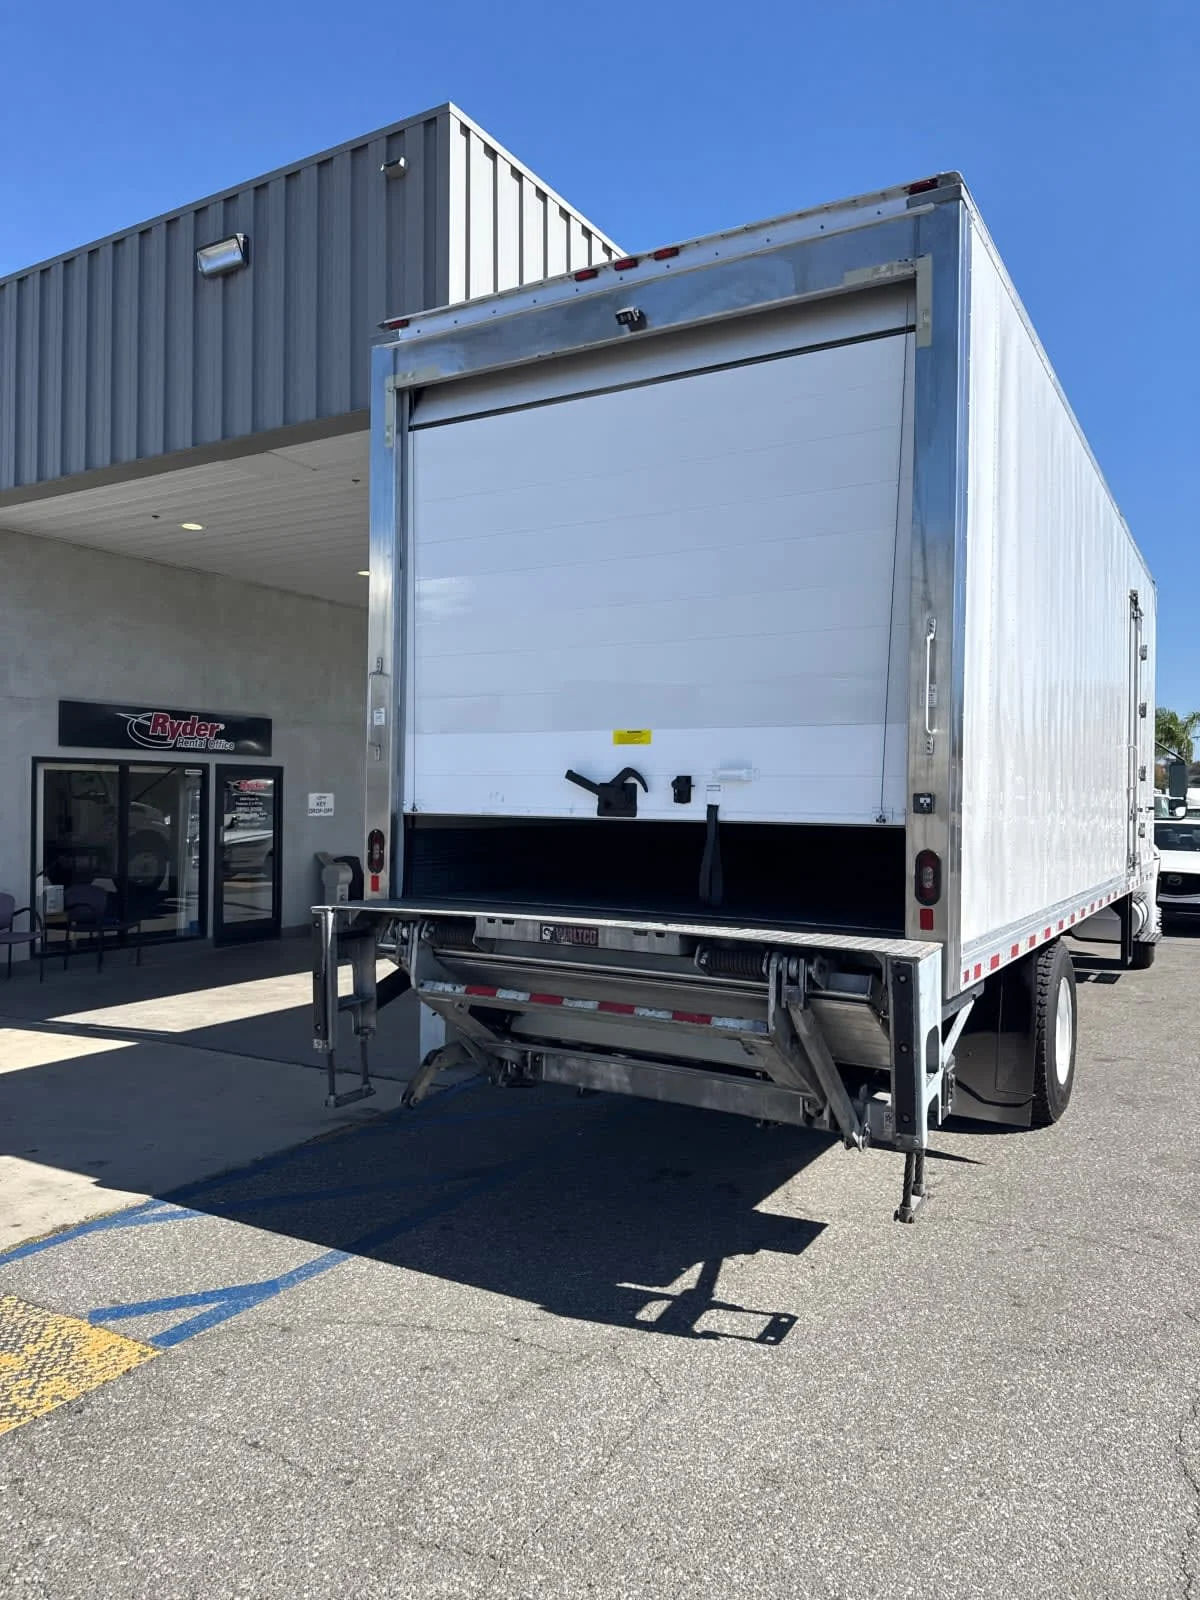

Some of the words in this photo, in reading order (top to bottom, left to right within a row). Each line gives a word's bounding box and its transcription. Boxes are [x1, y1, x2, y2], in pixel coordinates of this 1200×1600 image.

[149, 712, 221, 742] Ryder
[176, 736, 206, 748] Rental
[207, 739, 235, 751] Office
